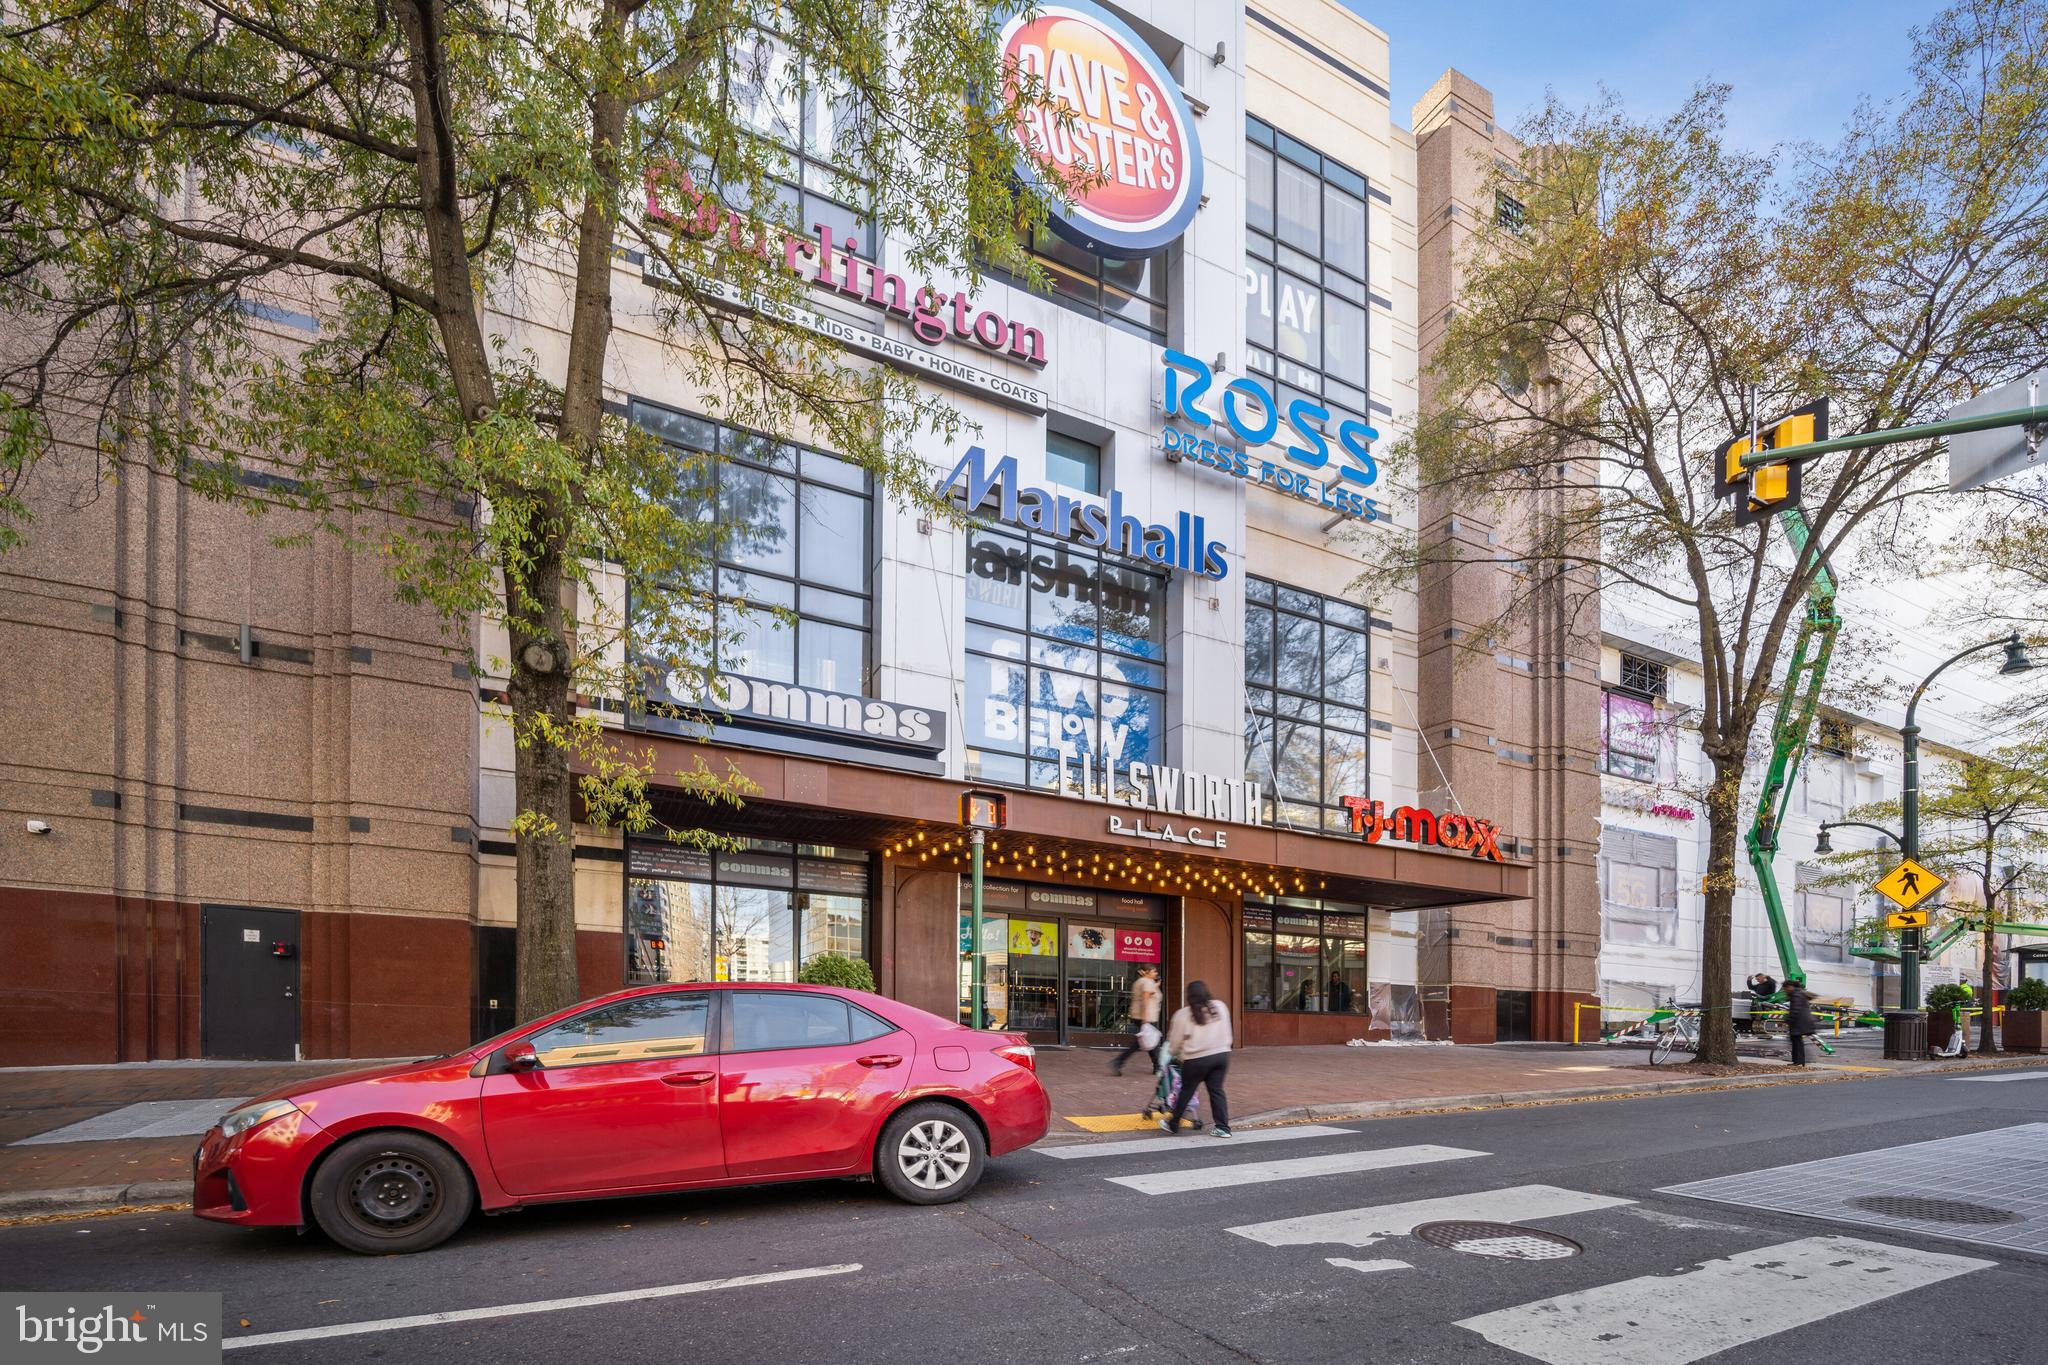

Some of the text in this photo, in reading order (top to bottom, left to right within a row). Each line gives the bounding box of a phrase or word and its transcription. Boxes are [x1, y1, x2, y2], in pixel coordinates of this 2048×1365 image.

[1019, 44, 1172, 145] DAVE &
[1020, 104, 1175, 191] BUSTER'S
[1245, 267, 1316, 334] PLAY
[814, 315, 854, 341] KIDS
[871, 336, 914, 361] BABY
[929, 357, 976, 383] HOME
[990, 378, 1039, 404] COATS
[1164, 348, 1379, 487] ROSS
[1164, 426, 1378, 521] DRESS FOR LESS
[936, 445, 1228, 581] Marshalls
[665, 667, 932, 742] commas
[1058, 748, 1262, 827] ELLSWORTH
[719, 861, 790, 878] commas
[1108, 815, 1227, 848] PLACE
[1031, 891, 1094, 907] commas
[1121, 897, 1134, 905] food
[1277, 916, 1319, 927] commas
